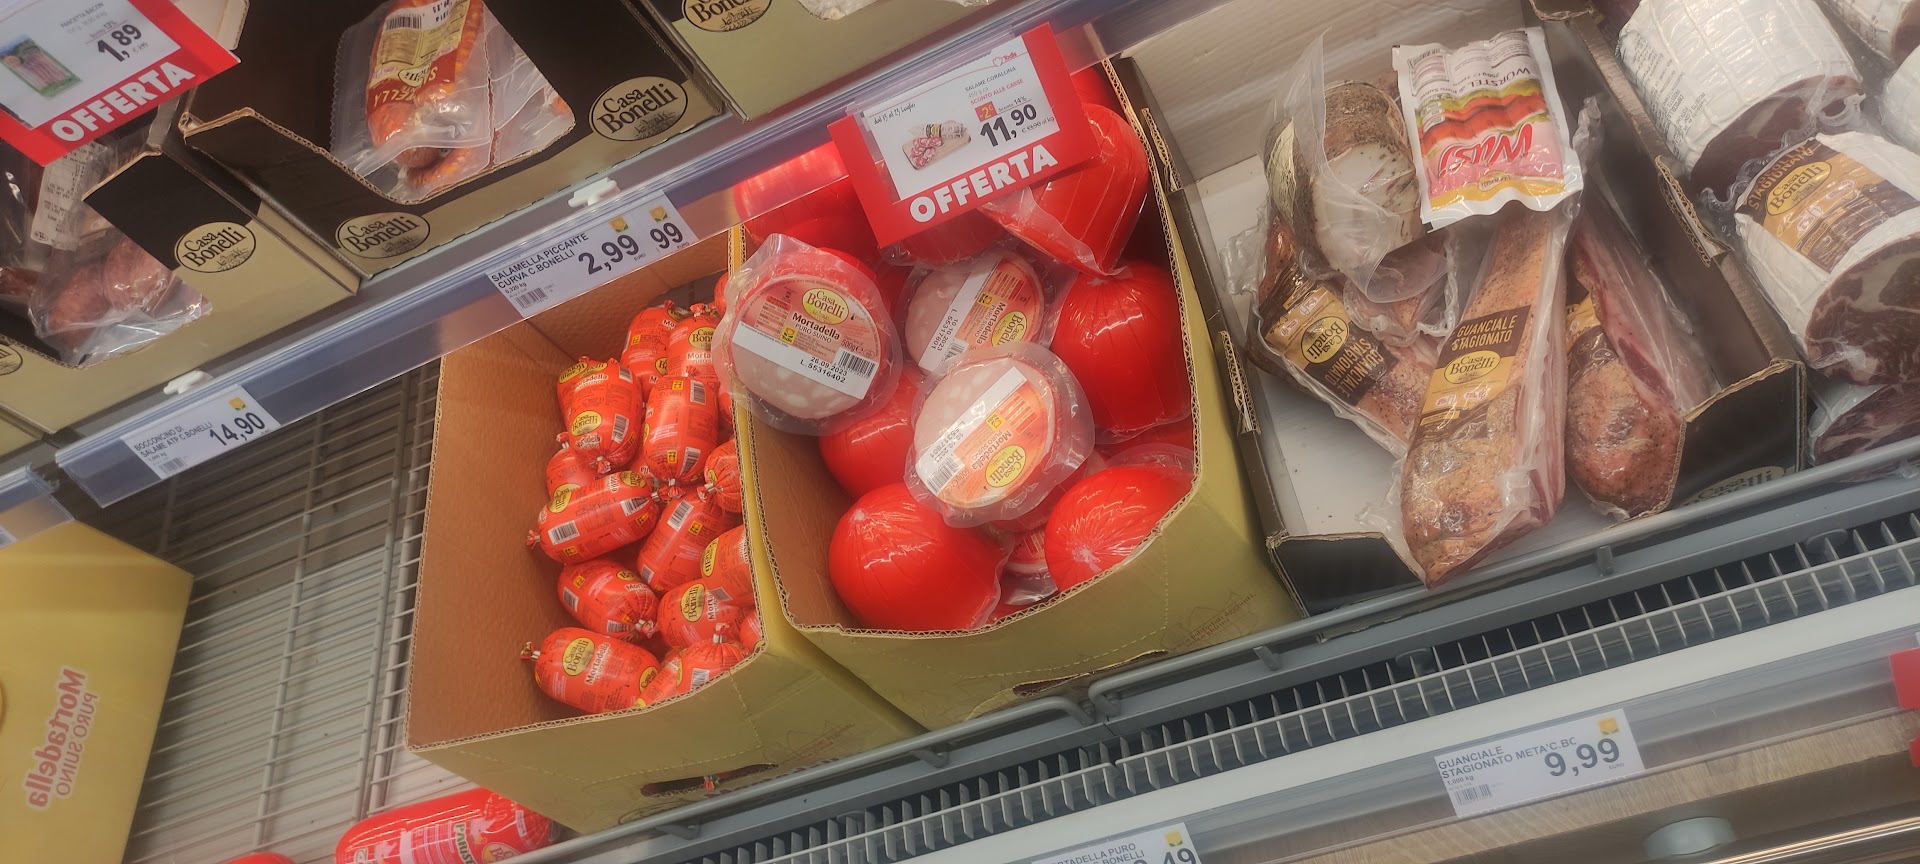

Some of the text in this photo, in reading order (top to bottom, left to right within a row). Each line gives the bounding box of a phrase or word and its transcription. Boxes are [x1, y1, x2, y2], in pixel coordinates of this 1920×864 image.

[98, 24, 142, 62] 1,89
[964, 66, 1017, 93] SALAME CORALLINA
[970, 78, 1024, 106] SCONTO ALLE CASSE
[51, 61, 196, 143] OFFERTA
[597, 83, 678, 134] Bonelli
[603, 89, 646, 113] Casa
[980, 104, 1037, 148] 11,90
[909, 144, 1059, 223] OFFERTA
[1769, 165, 1824, 211] Bonelli
[1773, 173, 1800, 198] Casa
[184, 232, 219, 252] Casa
[344, 216, 420, 252] Bonelli
[347, 220, 387, 238] Casa
[182, 226, 247, 268] Bonelli
[491, 233, 589, 283] SALAMELLA PICCANTE
[578, 222, 684, 275] 2,99 99
[498, 250, 576, 289] CURVA C.BONELLI
[504, 284, 521, 295] 0,320
[520, 281, 528, 289] kg
[816, 290, 836, 305] Casa
[806, 292, 845, 319] Bonelli
[792, 312, 840, 340] Mortadella
[794, 323, 812, 335] PURO
[812, 331, 832, 343] SUINO
[974, 304, 997, 338] PURO SUINO
[976, 302, 1007, 345] Mortadella
[1009, 323, 1025, 341] Casa
[1457, 314, 1518, 338] GUANCIALE
[840, 339, 857, 353] 500g
[1306, 321, 1345, 360] Bonelli
[1323, 336, 1343, 354] Casa
[1451, 329, 1513, 352] STAGIONATO
[687, 352, 711, 360] Morta
[810, 356, 848, 376] 26.09.2023
[1324, 338, 1372, 386] STAGIONATO
[1449, 356, 1496, 376] Bonelli
[1460, 355, 1484, 365] Casa
[1342, 350, 1384, 399] GUANCIALE
[133, 425, 184, 452] BOCCONCINO DI
[209, 412, 266, 446] 14,90
[140, 442, 168, 458] SALAME
[167, 437, 180, 447] ATP
[971, 431, 1003, 461] PURO SUINO
[971, 430, 1012, 470] Mortadella
[989, 449, 1024, 484] Bonelli
[1005, 461, 1022, 478] Casa
[688, 586, 701, 619] Bonelli
[565, 645, 578, 664] Casa
[567, 639, 590, 672] Bonelli
[586, 641, 610, 685] Mortadella
[1438, 745, 1505, 771] GUANCIALE
[1441, 754, 1514, 779] STAGIONATO
[1544, 737, 1620, 777] 9,99
[1608, 762, 1625, 770] EURO
[1446, 777, 1464, 787] 1,000
[1464, 774, 1475, 783] kg
[1108, 843, 1137, 856] PURO
